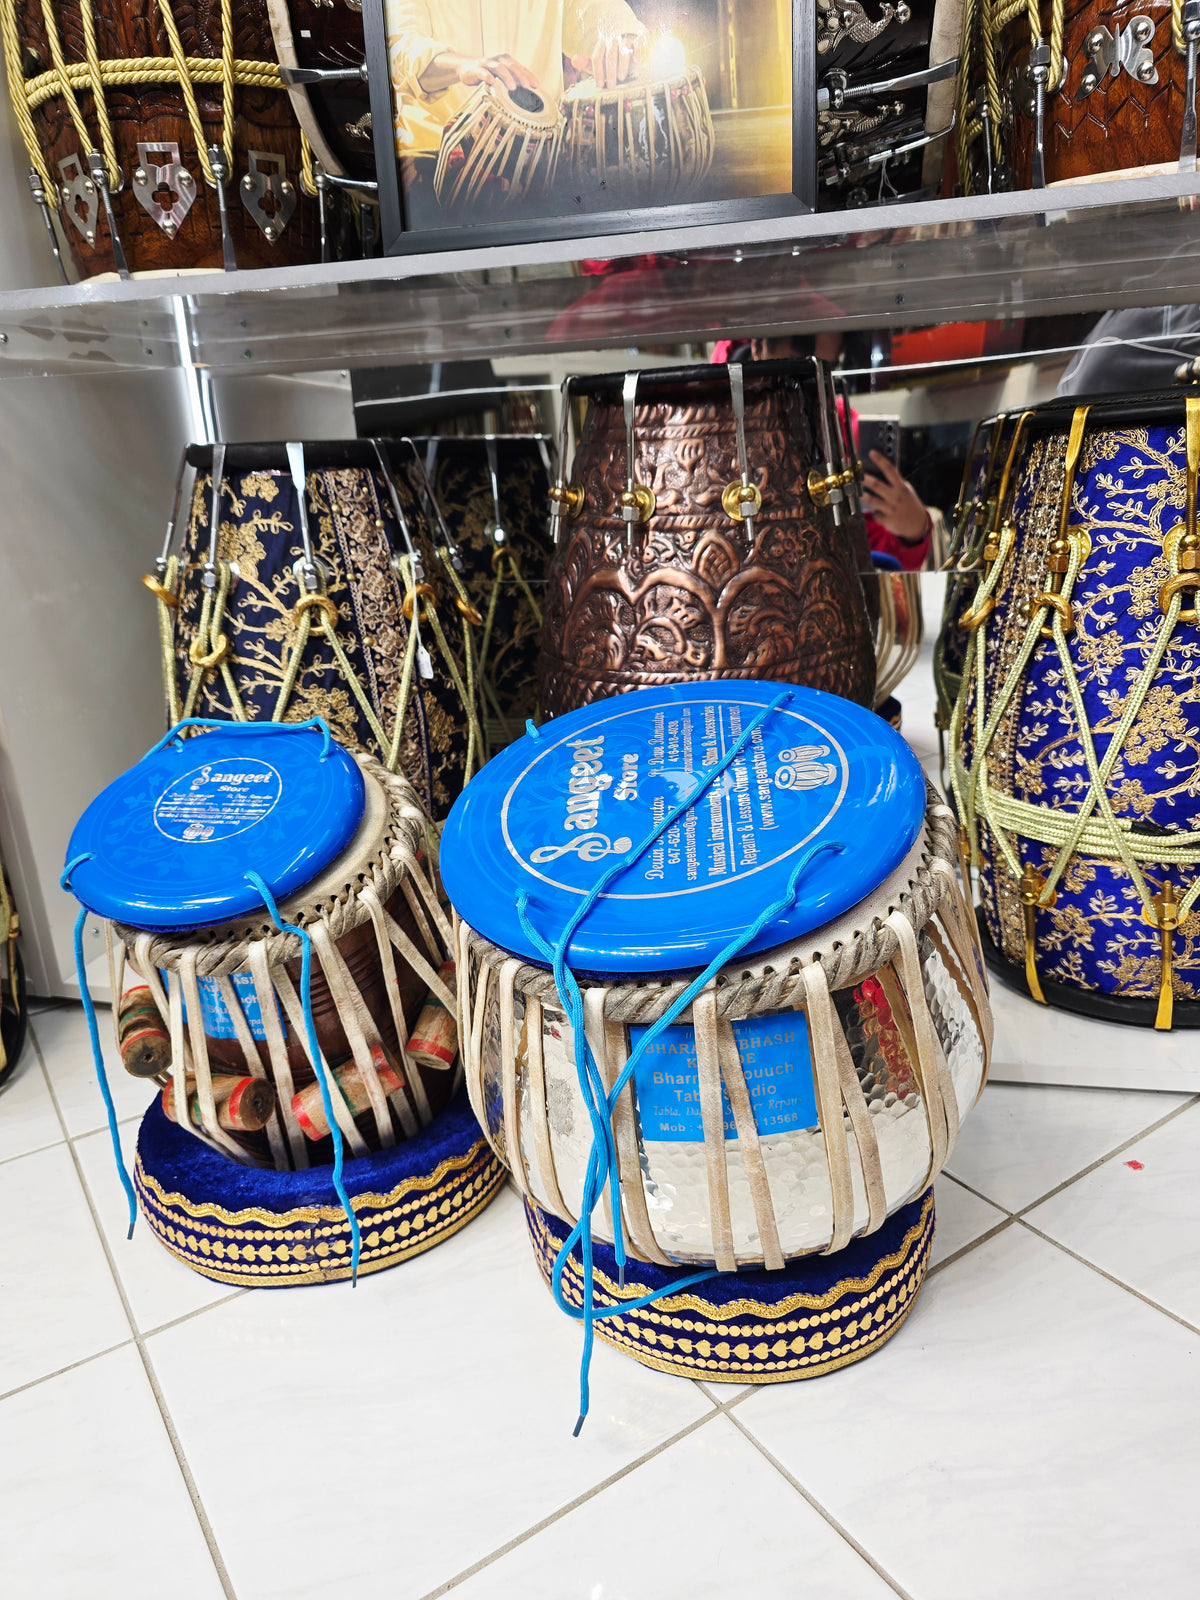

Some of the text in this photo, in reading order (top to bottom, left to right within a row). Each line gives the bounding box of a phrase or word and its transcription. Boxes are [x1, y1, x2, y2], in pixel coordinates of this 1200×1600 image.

[700, 705, 717, 739] Accessories
[190, 766, 272, 791] Sangeet
[613, 753, 639, 801] Store
[732, 766, 749, 792] Offered
[737, 792, 753, 824] Lessons
[736, 824, 754, 832] &
[707, 842, 727, 877] Musical
[738, 833, 761, 866] Repairs
[738, 1031, 795, 1050] BHASH
[743, 1061, 794, 1080] ouuch
[722, 1083, 777, 1100] Sdio
[660, 1122, 686, 1132] Mob
[764, 1112, 798, 1126] 13568
